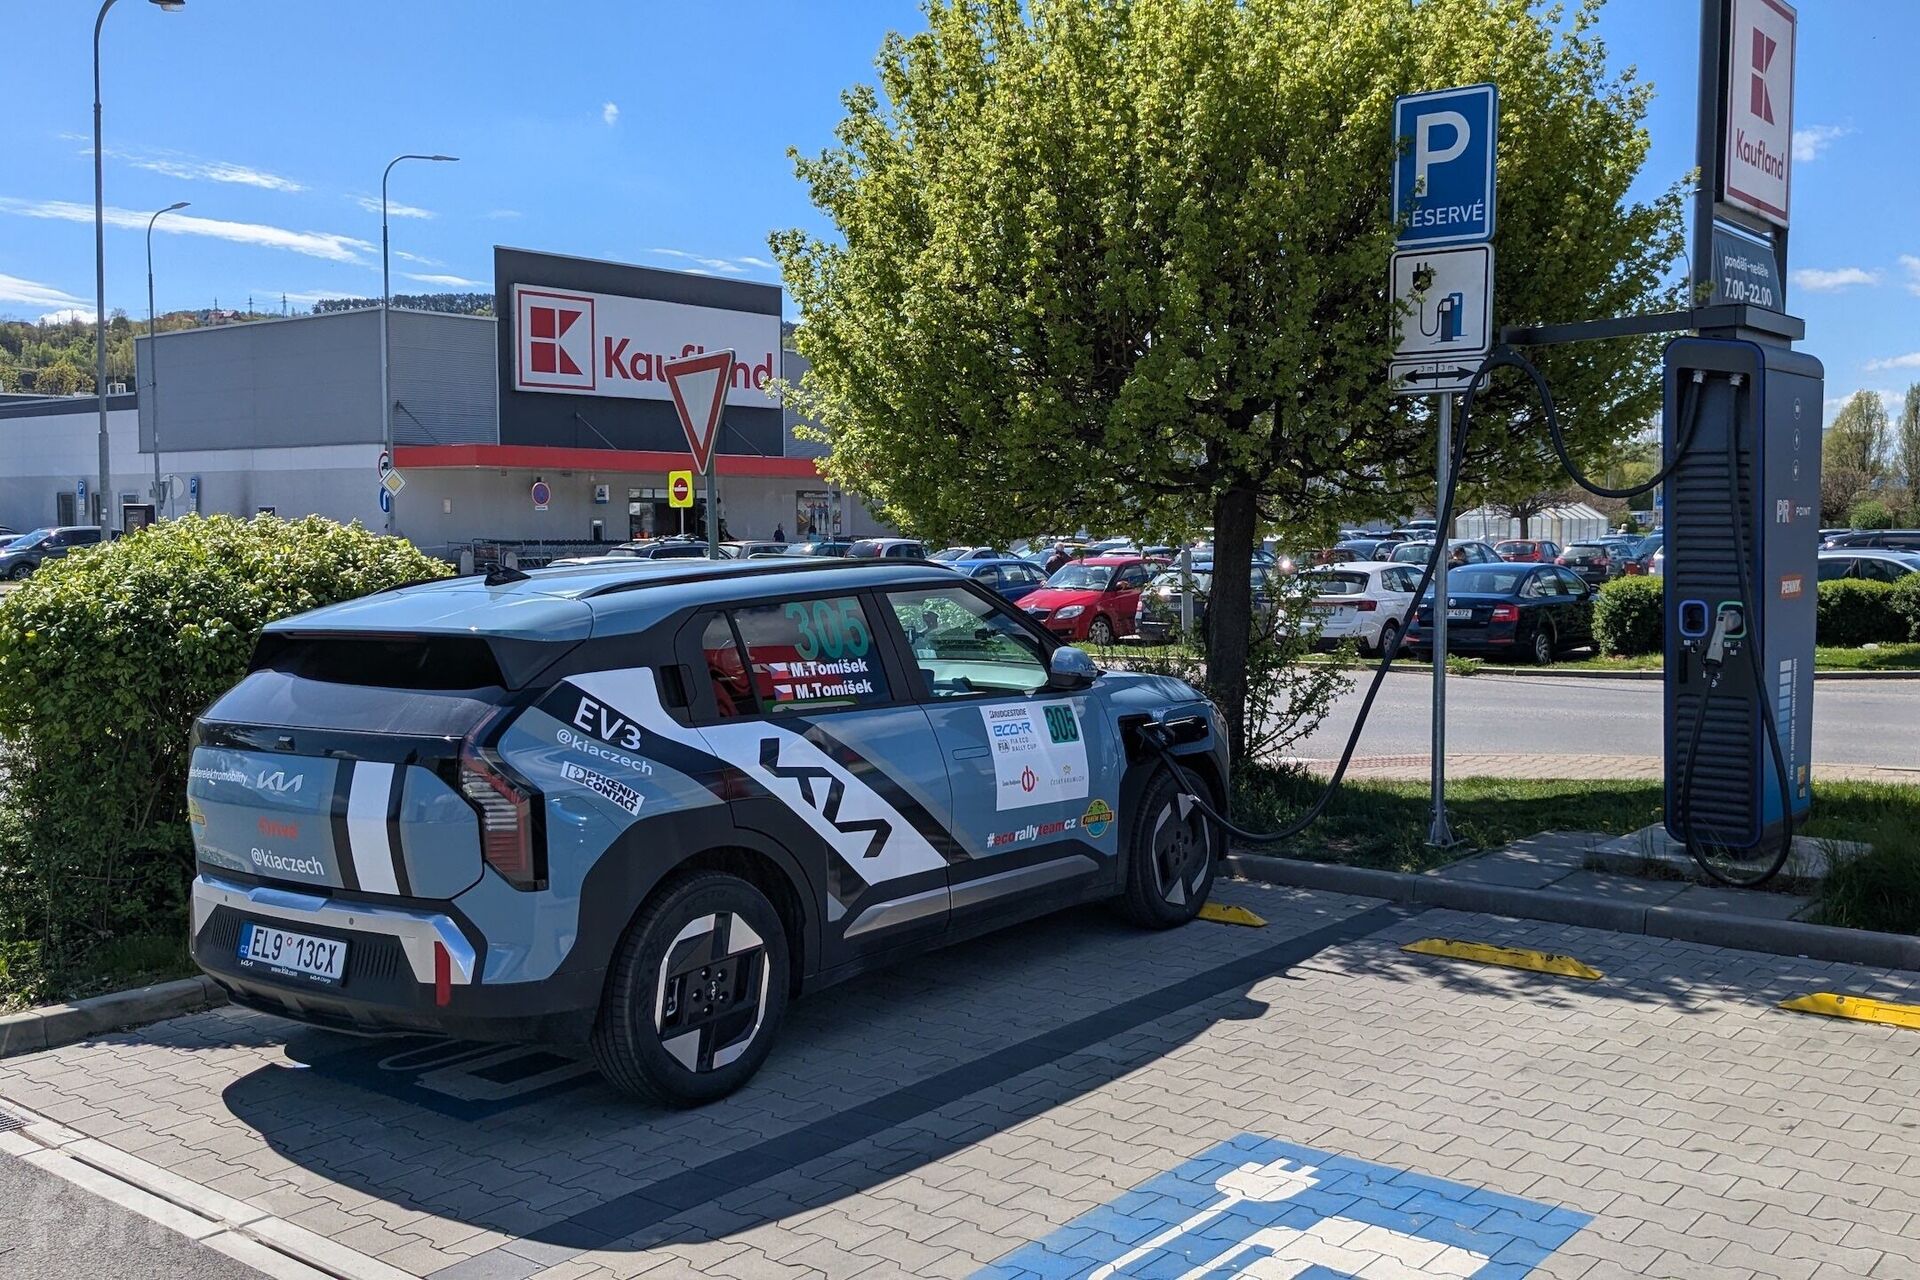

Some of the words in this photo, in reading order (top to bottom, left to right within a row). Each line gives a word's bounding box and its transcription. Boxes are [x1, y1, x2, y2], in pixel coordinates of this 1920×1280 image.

[1415, 111, 1471, 198] P
[1736, 128, 1784, 181] Kaufland
[604, 335, 773, 391] Kaund
[785, 599, 869, 660] 305
[789, 658, 869, 678] M.Tomíšek
[794, 679, 874, 699] M.Tomíšek
[573, 696, 641, 750] EV3
[989, 708, 1028, 719] BRIDGESTONE
[1044, 705, 1079, 741] 305
[557, 729, 653, 776] @kiaczech
[256, 769, 304, 793] KIA
[585, 778, 638, 812] CONTACT
[986, 818, 1077, 848] #ecorallyteamcz
[251, 848, 325, 876] @kiaczech
[251, 928, 283, 960] EL9
[296, 938, 338, 974] 13CX
